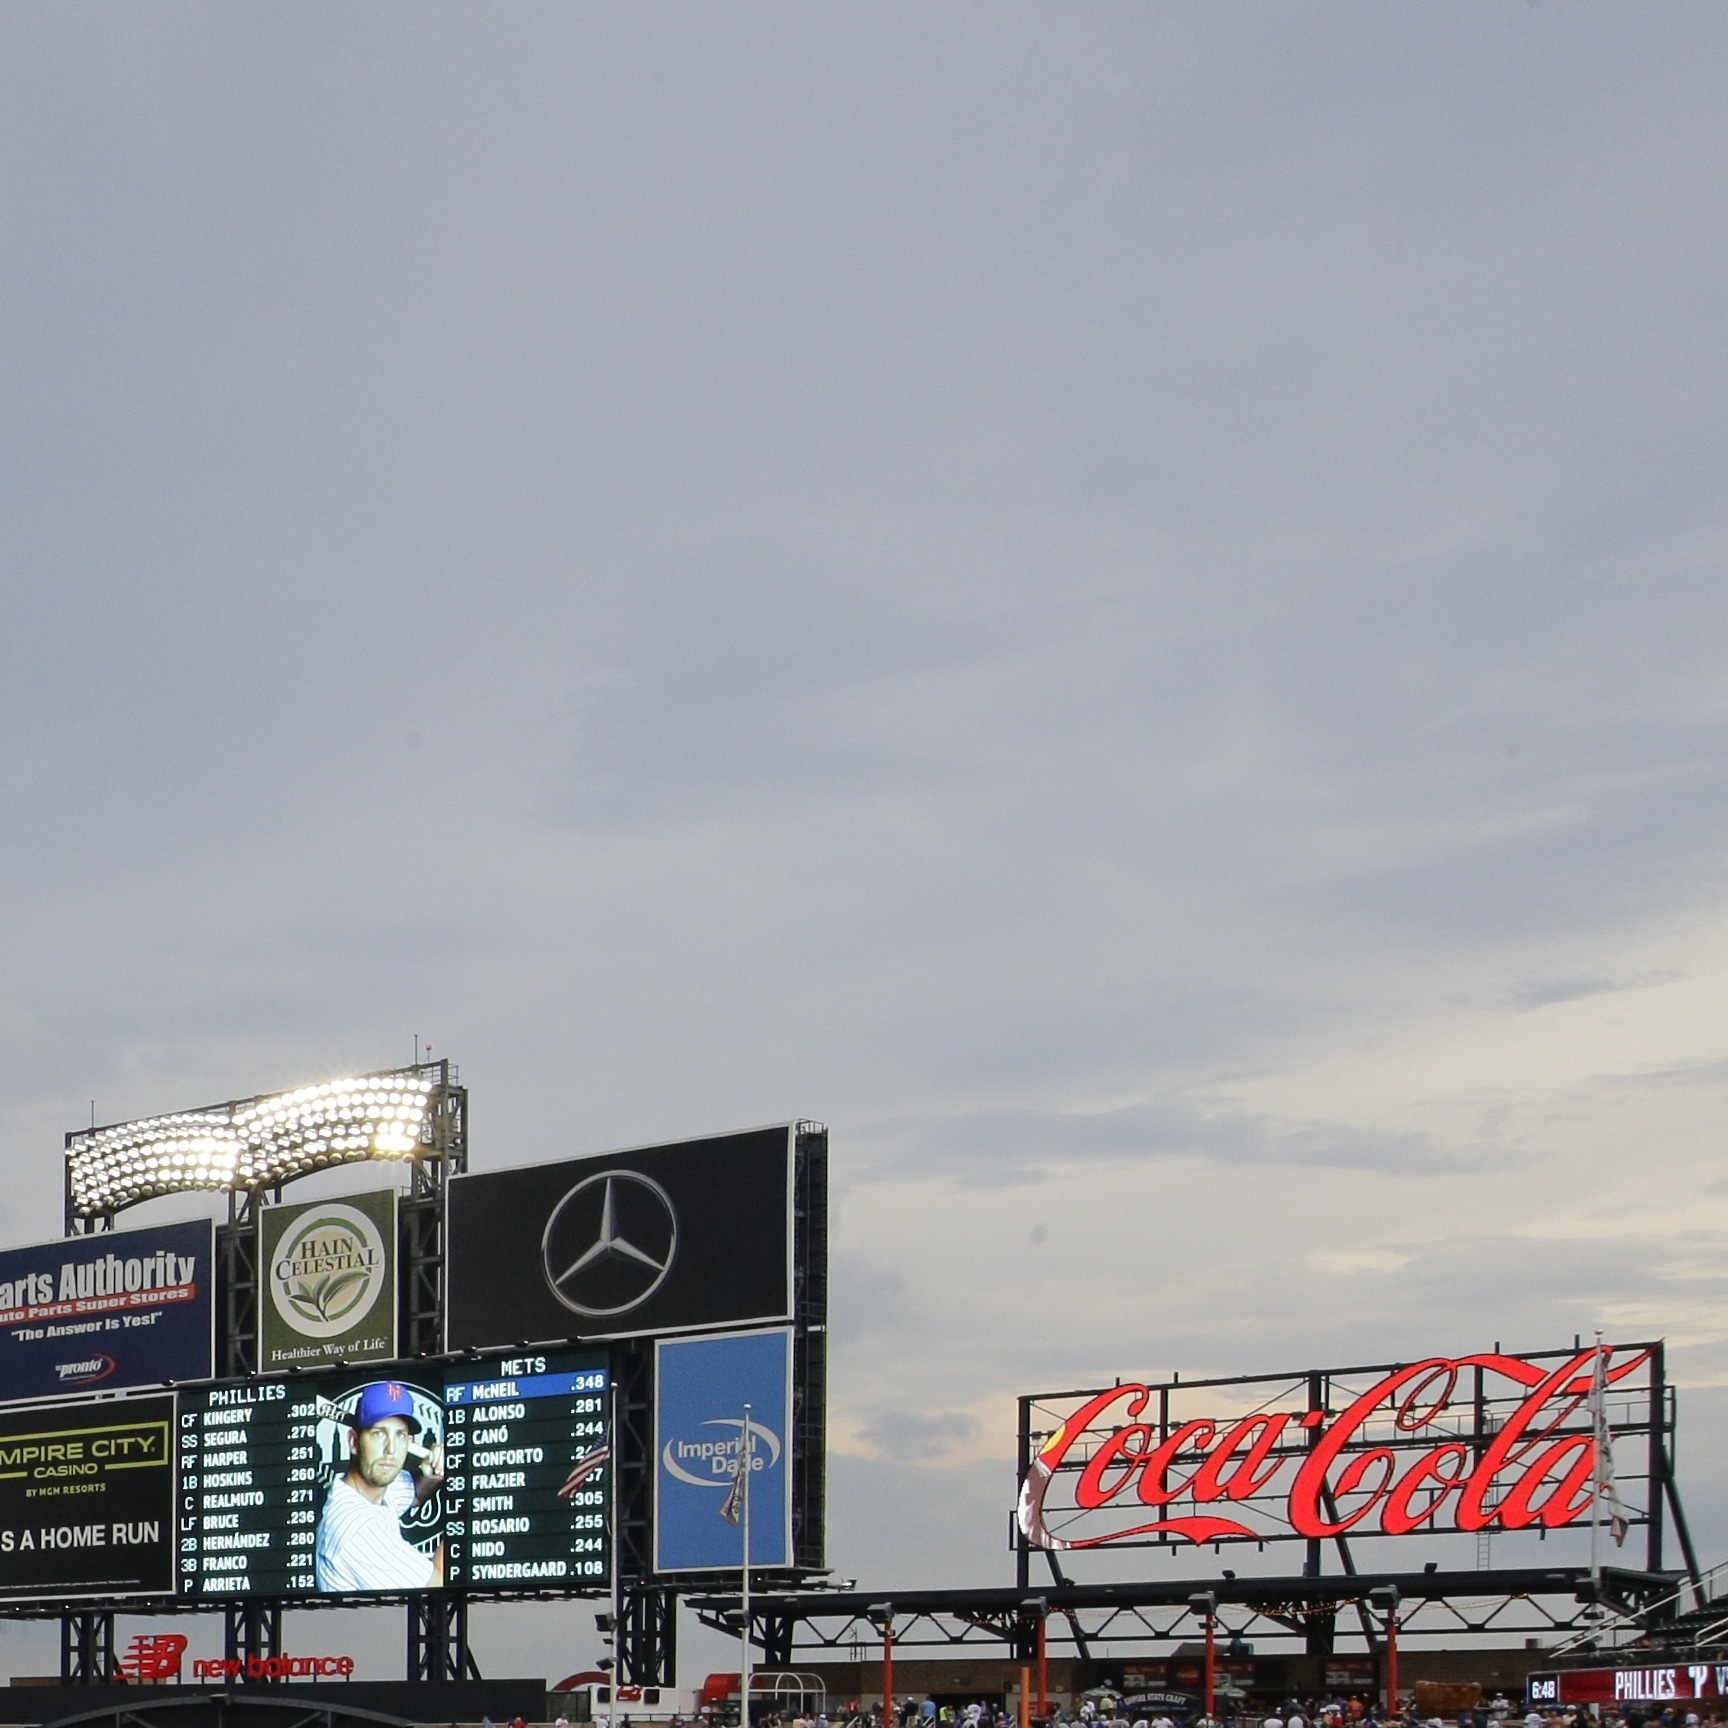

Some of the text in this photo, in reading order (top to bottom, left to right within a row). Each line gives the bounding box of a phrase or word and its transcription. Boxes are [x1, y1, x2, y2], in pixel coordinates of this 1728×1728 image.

[301, 1237, 353, 1259] HAIN
[276, 1249, 379, 1281] CELESTIAL
[59, 1251, 195, 1301] Authority
[29, 1304, 72, 1318] Parts
[76, 1297, 127, 1312] Super
[130, 1289, 188, 1304] Stores
[47, 1319, 101, 1337] Answer
[106, 1319, 119, 1330] Is
[272, 1338, 385, 1361] Healthier Way of Life
[501, 1357, 546, 1376] METS
[209, 1385, 286, 1406] PHILLIES
[472, 1386, 519, 1400] McNEIL
[203, 1408, 253, 1425] KINGERY
[472, 1404, 525, 1422] ALONSO
[204, 1430, 247, 1446] SEGURA
[472, 1425, 508, 1445] CANÓ
[1017, 1338, 1664, 1550] Coca-Cola
[92, 1436, 155, 1457] CITY
[203, 1451, 247, 1467] HARPER
[472, 1448, 543, 1467] CONFORTO
[34, 1463, 98, 1478] CASINO
[203, 1471, 253, 1488] HOSKINS
[26, 1483, 106, 1497] BY MGM RESORTS
[472, 1472, 526, 1490] FRAZIER
[203, 1491, 264, 1508] REALMUTO
[472, 1496, 513, 1512] SMITH
[203, 1514, 239, 1530] BRUCE
[472, 1518, 530, 1536] ROSARIO
[20, 1530, 35, 1550] A
[41, 1525, 105, 1549] HOME
[113, 1521, 159, 1544] RUN
[203, 1532, 270, 1550] HERNÁNDEZ
[472, 1542, 505, 1557] NIDO
[203, 1556, 247, 1571] FRANCO
[472, 1561, 566, 1580] SYNDERGAARD
[203, 1577, 250, 1592] ARRIETA
[193, 1652, 356, 1677] new balance
[1532, 1680, 1555, 1699] 6:48
[1616, 1670, 1675, 1700] PHILLIES
